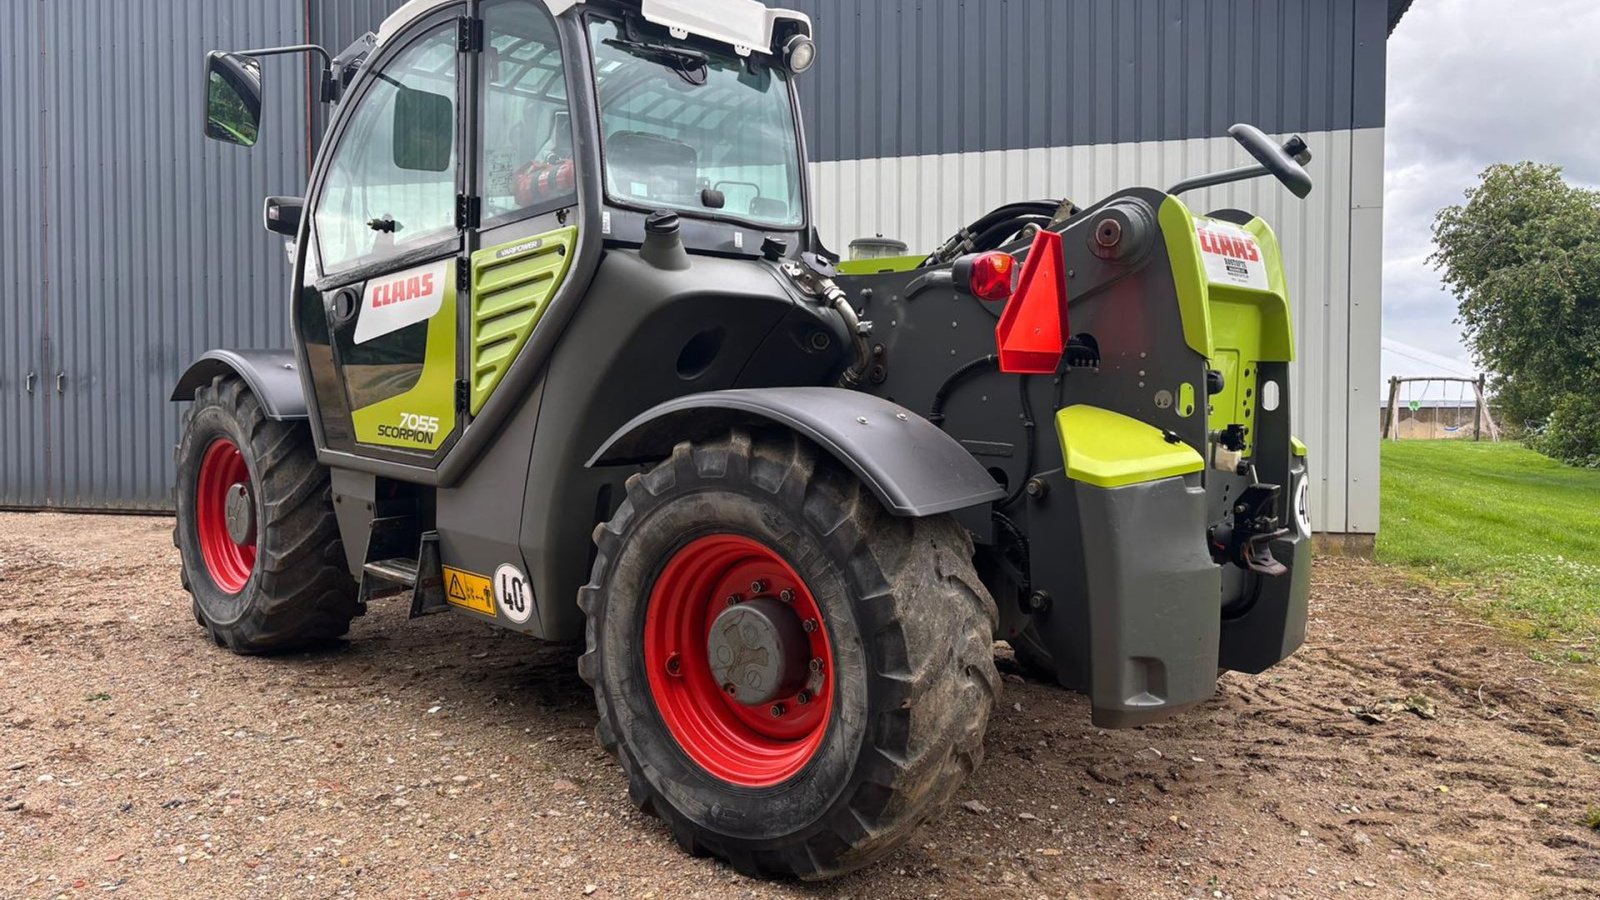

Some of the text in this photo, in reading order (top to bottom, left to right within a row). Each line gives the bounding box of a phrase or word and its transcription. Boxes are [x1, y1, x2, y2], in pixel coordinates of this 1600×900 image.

[1196, 227, 1259, 263] CLAAS
[372, 273, 433, 307] CLAAS
[377, 424, 434, 445] SCORPION
[399, 413, 440, 433] 7055
[502, 573, 525, 613] 40
